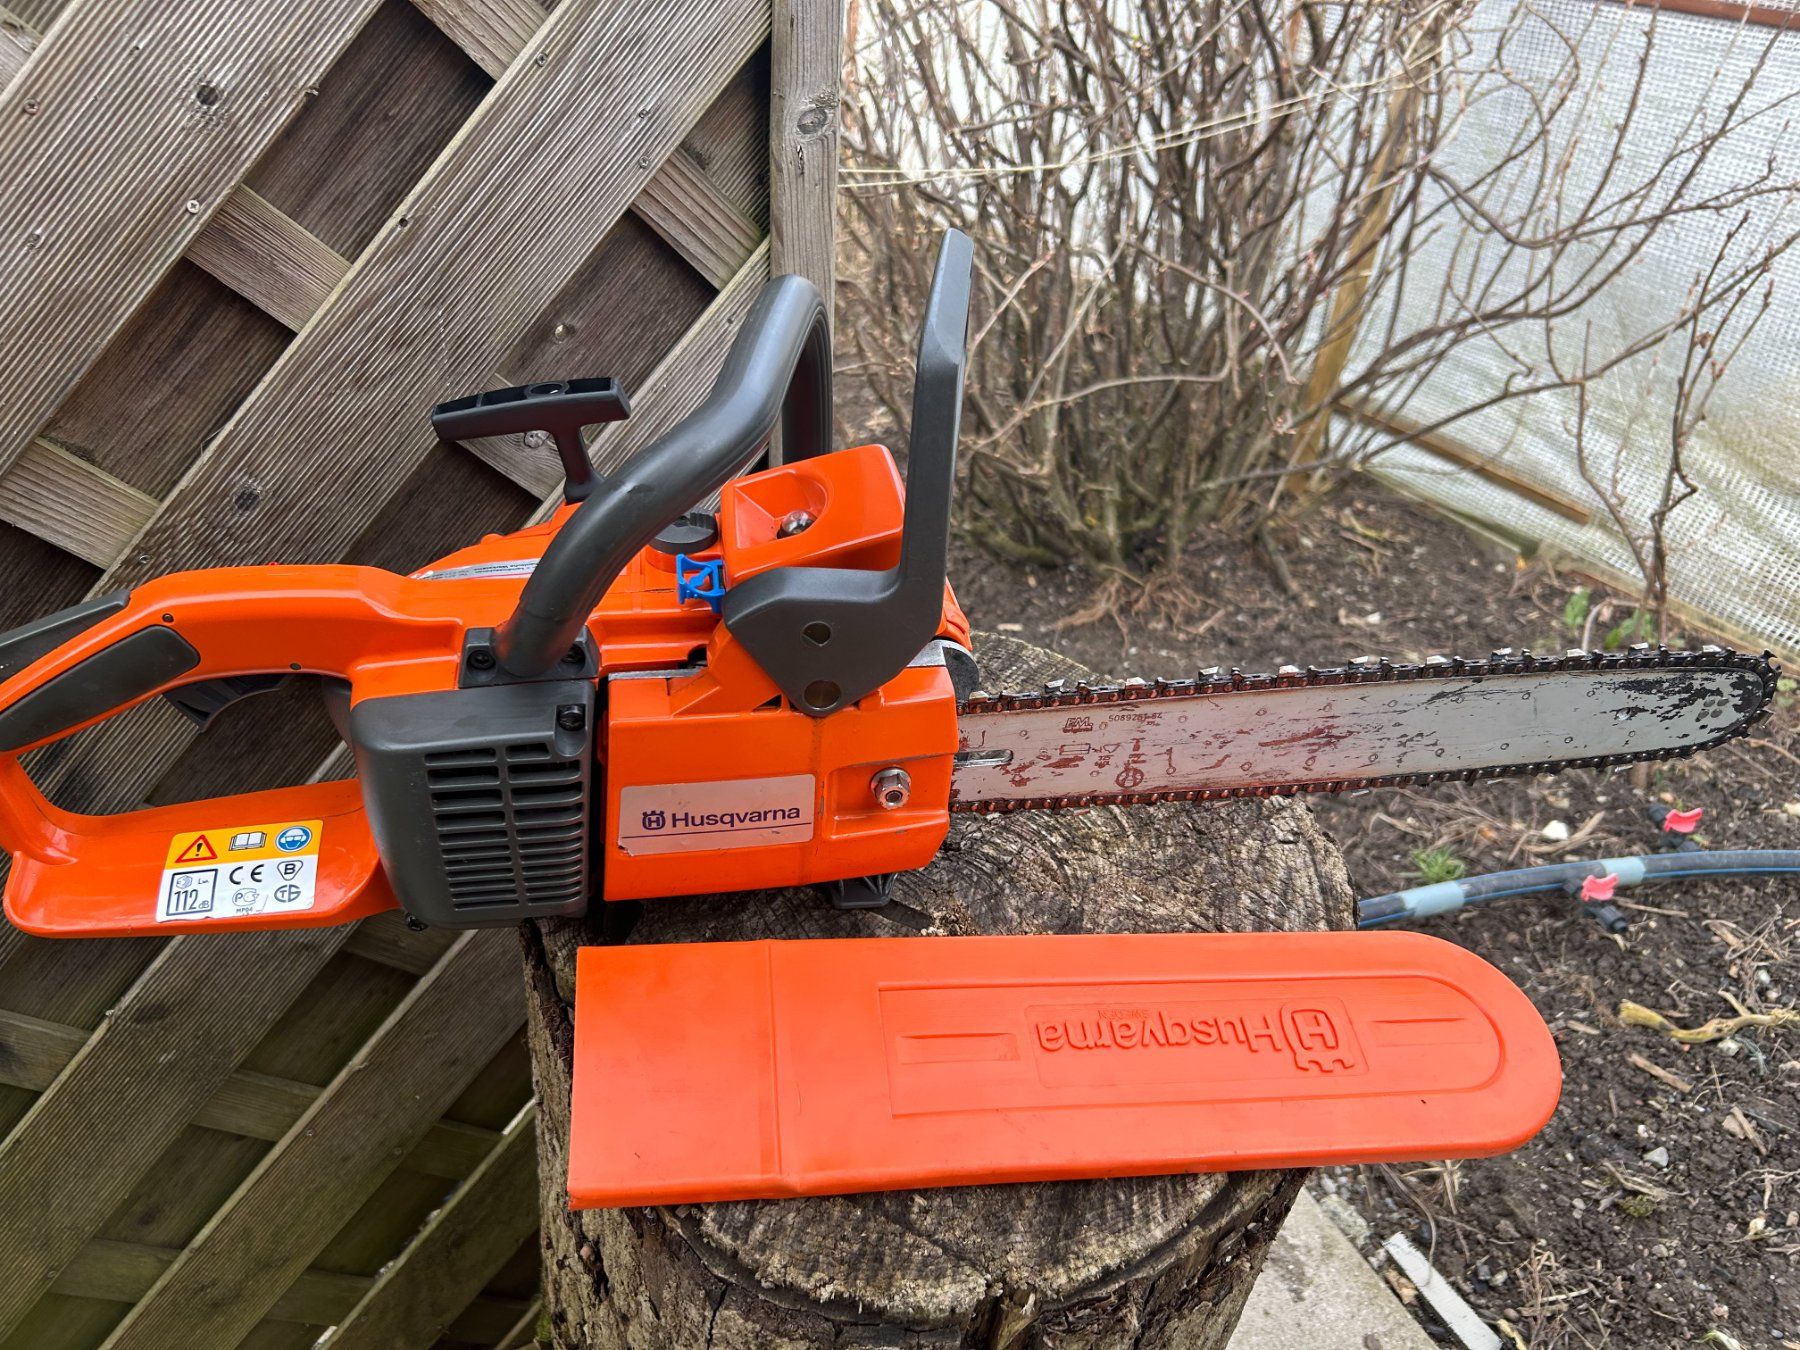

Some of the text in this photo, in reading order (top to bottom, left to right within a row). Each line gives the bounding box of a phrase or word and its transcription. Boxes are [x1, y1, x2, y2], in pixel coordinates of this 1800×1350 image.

[672, 807, 800, 828] Husqvarna
[229, 864, 264, 885] CE
[284, 863, 296, 875] B
[174, 889, 199, 912] 112
[1036, 1011, 1283, 1053] Husqvarna
